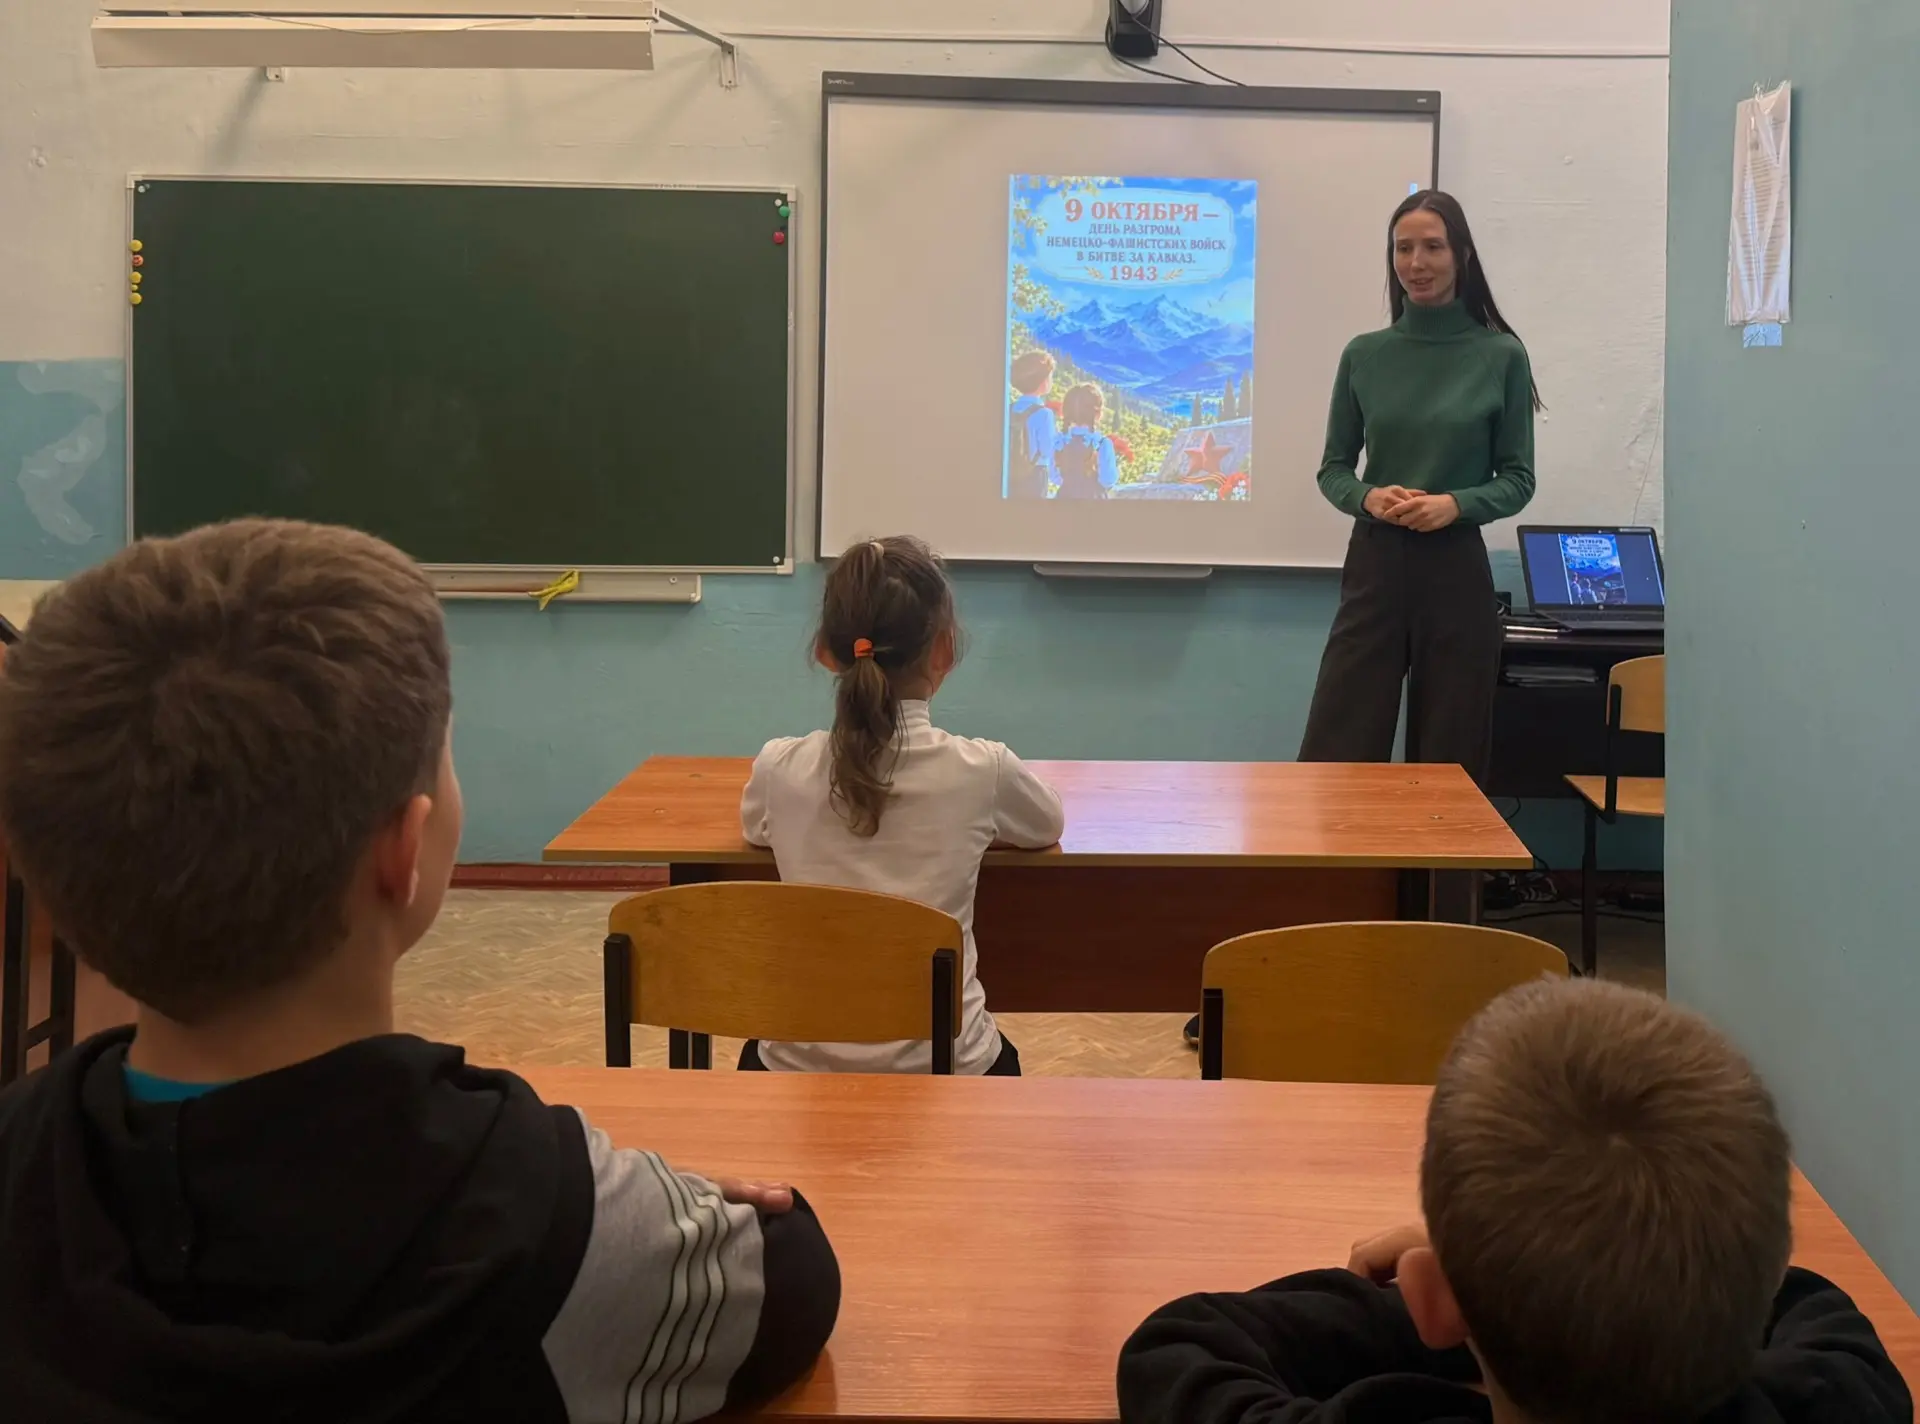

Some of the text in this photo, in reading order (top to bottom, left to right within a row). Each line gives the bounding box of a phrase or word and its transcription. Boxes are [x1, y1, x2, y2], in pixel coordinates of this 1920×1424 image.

[1064, 198, 1083, 222] 9
[1091, 202, 1200, 222] ОКТЯБРЯ
[1088, 224, 1181, 236] ДЕНЬ РАЗГРОМА
[1046, 237, 1226, 250] НЕМЕЦКО-ФАШИСТСКИХ ВОЙСК
[1076, 251, 1196, 264] В БИТВЕ ЗА КАВКАЗ.
[1110, 266, 1158, 281] 1943
